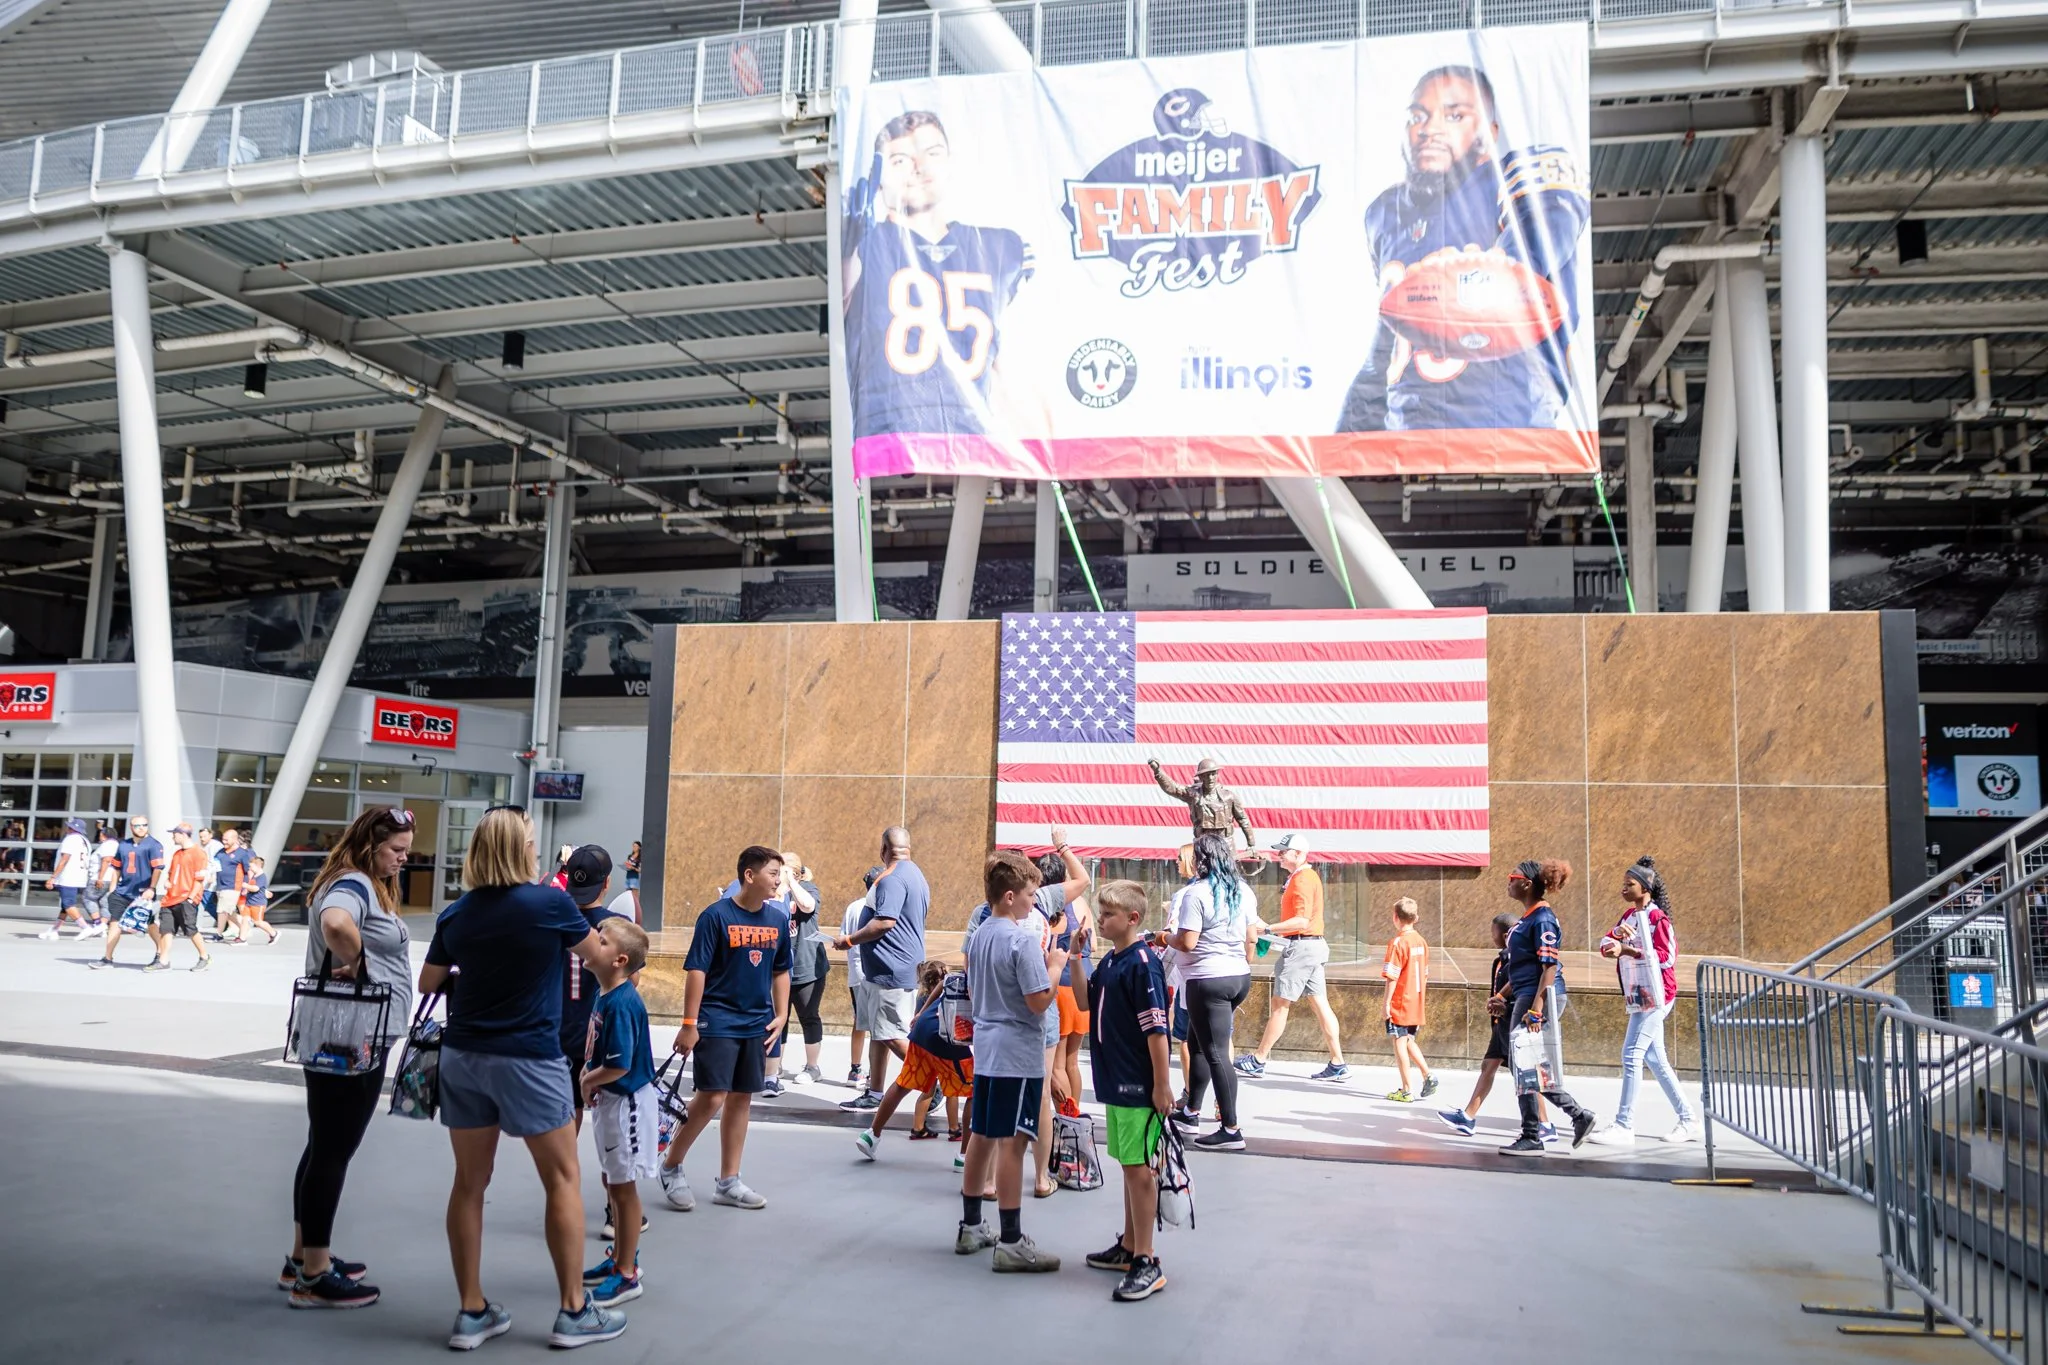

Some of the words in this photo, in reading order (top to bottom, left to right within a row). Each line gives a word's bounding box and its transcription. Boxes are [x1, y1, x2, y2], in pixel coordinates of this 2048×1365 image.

[1134, 141, 1243, 182] meijer
[1070, 171, 1314, 255] FAMILY
[1119, 239, 1248, 299] Fest
[884, 267, 994, 382] 85
[1068, 339, 1136, 370] UNDENIABLY
[1180, 356, 1313, 398] illinois
[1080, 393, 1121, 409] DAIRY
[1176, 560, 1325, 576] SOLDIE
[1942, 723, 2010, 738] verizon
[126, 851, 137, 874] 1
